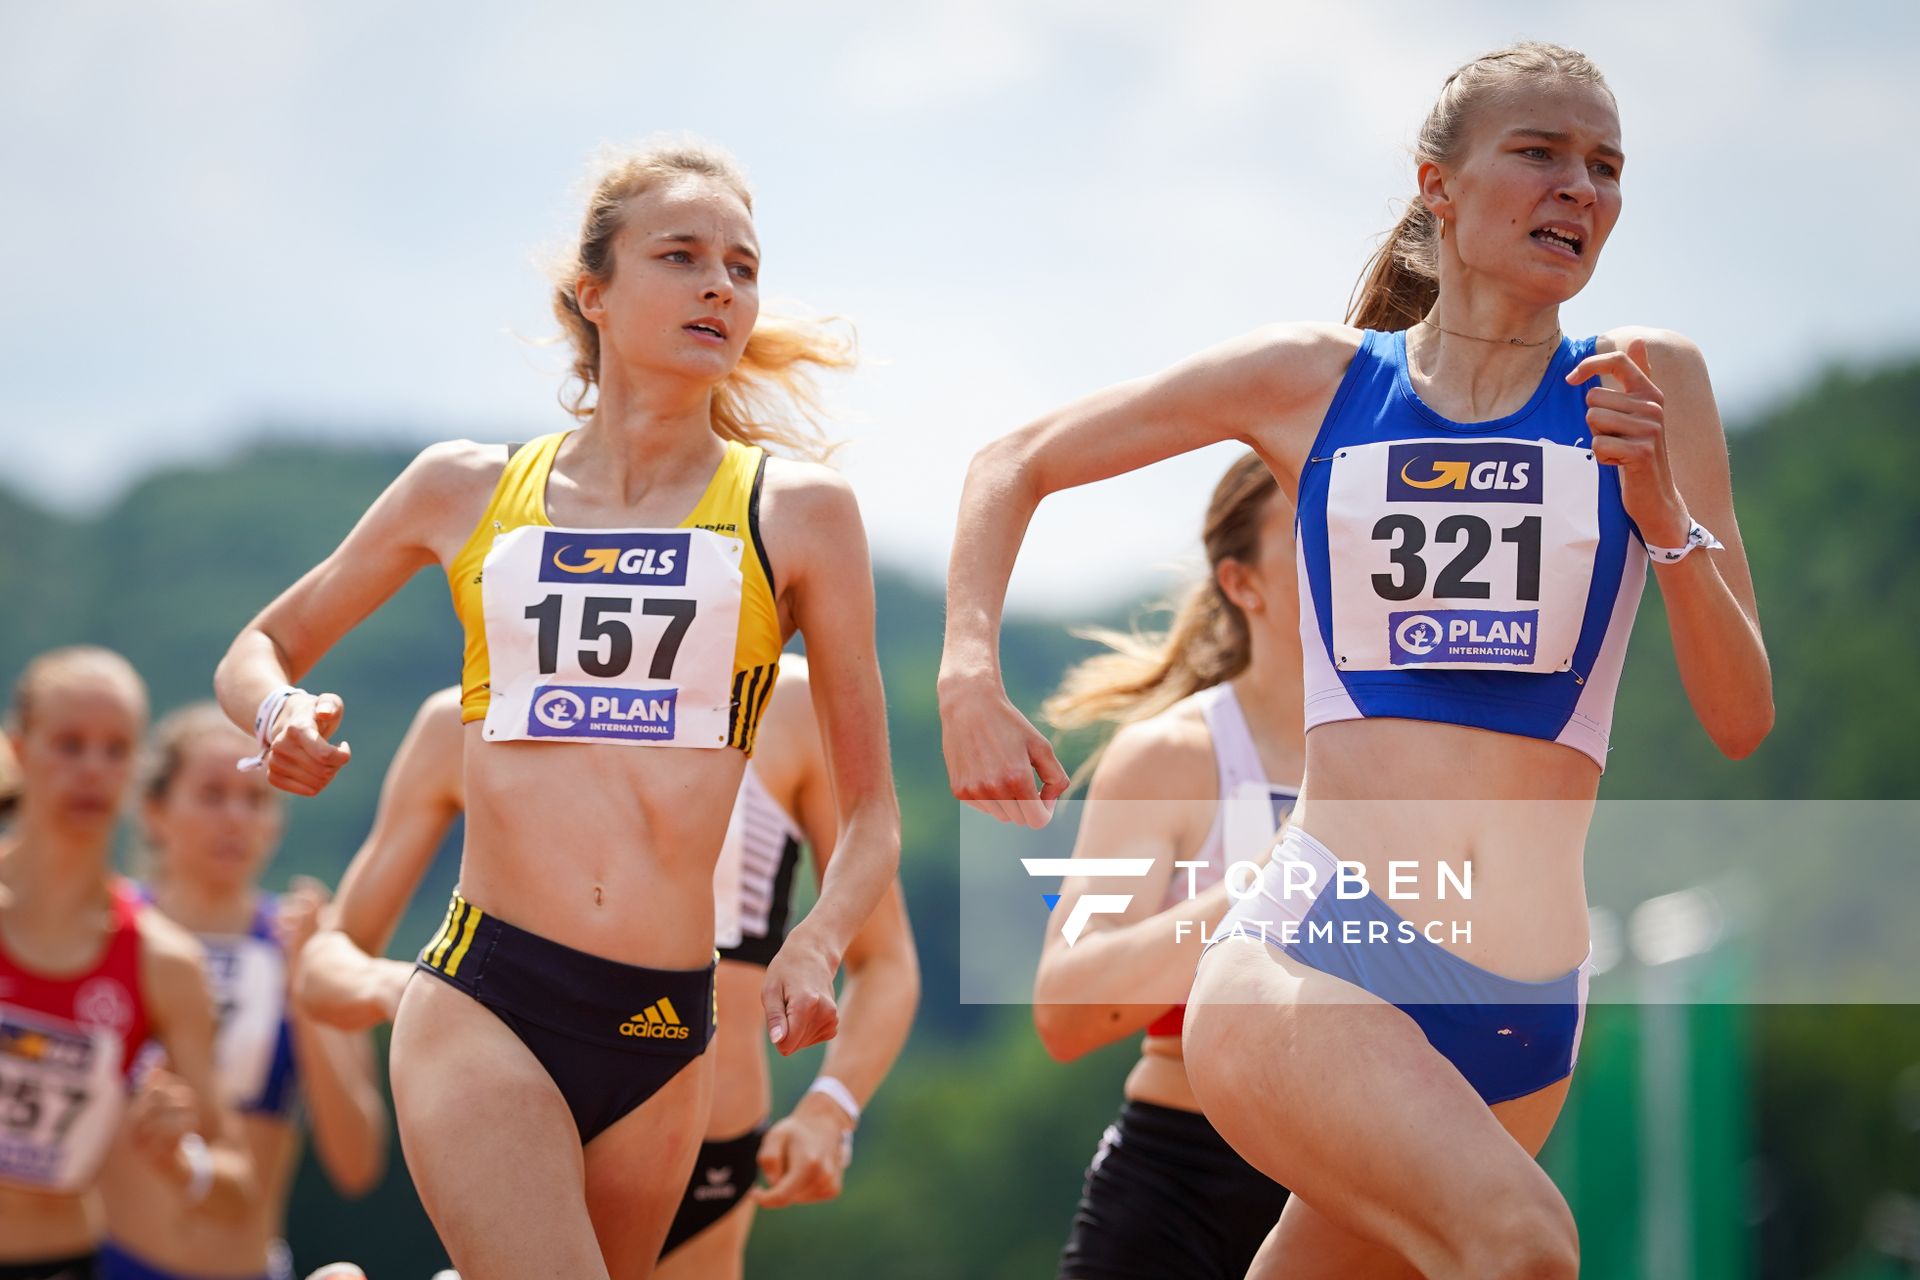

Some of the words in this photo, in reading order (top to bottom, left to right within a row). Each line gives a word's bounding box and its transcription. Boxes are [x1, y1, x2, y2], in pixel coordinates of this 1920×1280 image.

[1471, 461, 1530, 490] GLS
[618, 548, 677, 576] GLS
[1371, 513, 1542, 602] 321
[524, 594, 697, 680] 157
[1449, 619, 1531, 645] PLAN
[1449, 646, 1529, 657] INTERNATIONAL
[590, 696, 670, 722] PLAN
[590, 723, 669, 734] INTERNATIONAL
[619, 1021, 690, 1039] adidas
[0, 1072, 91, 1144] 57
